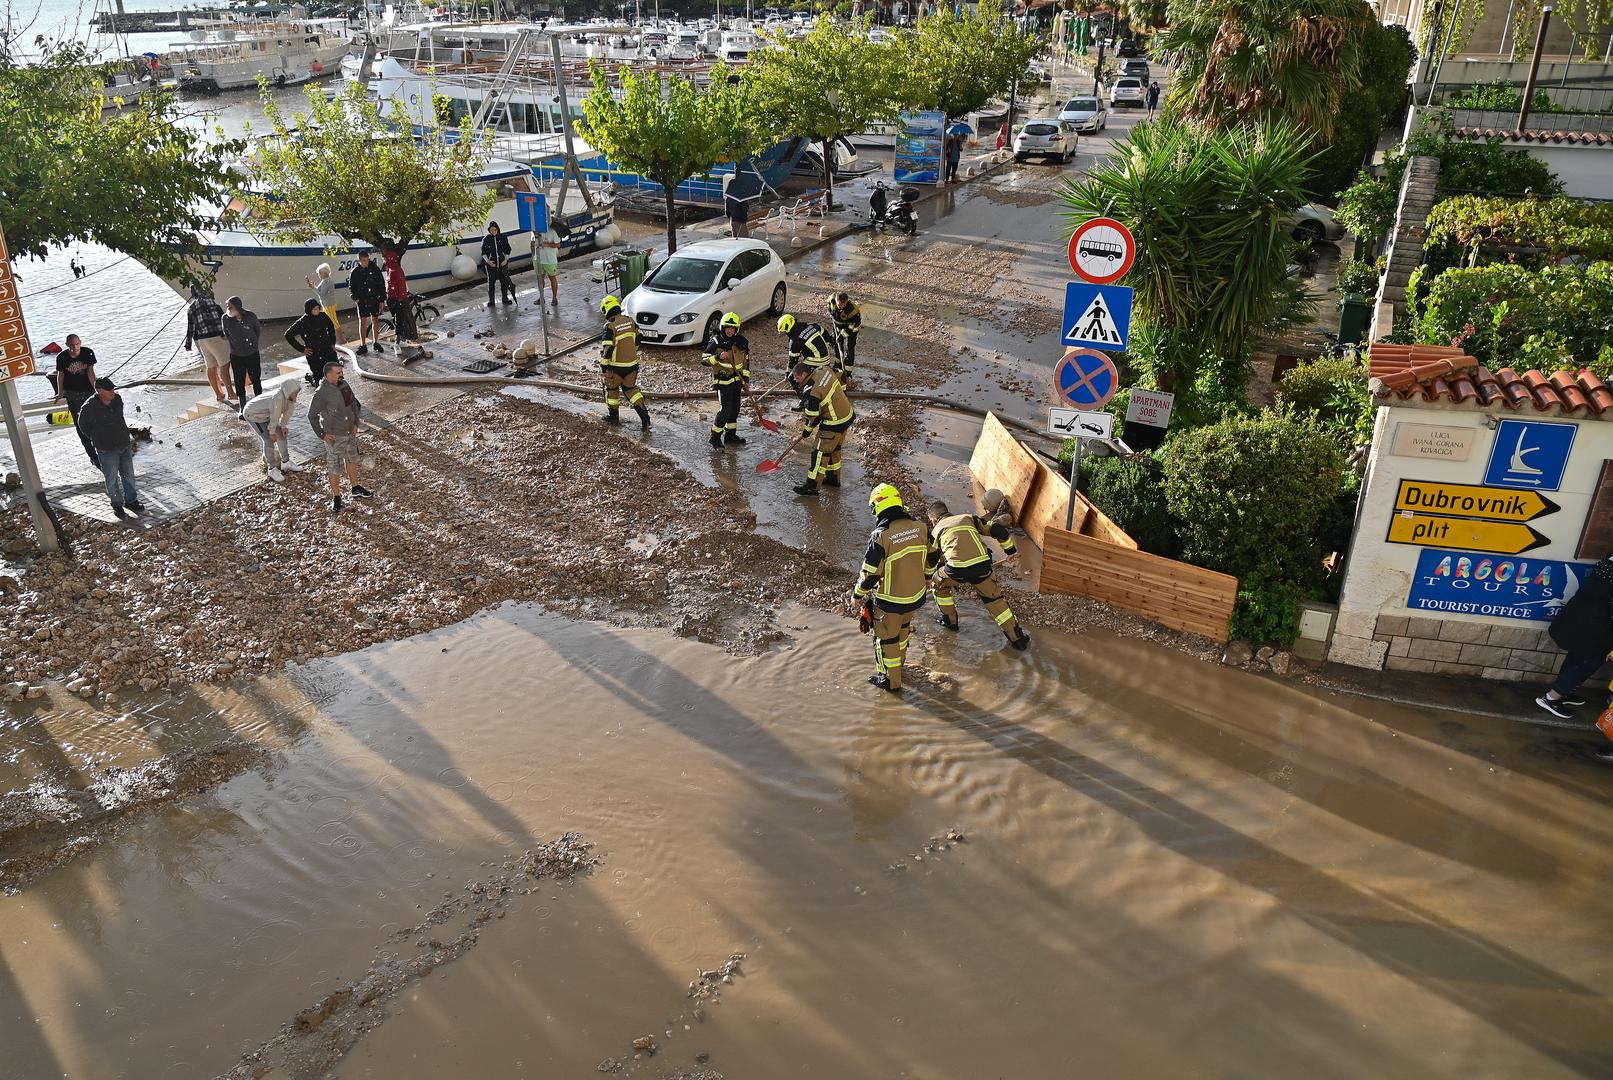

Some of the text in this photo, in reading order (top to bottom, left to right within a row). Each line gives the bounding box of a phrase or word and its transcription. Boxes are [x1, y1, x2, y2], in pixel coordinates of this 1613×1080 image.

[1132, 396, 1171, 410] APARTMANI
[1140, 406, 1158, 418] SOBE
[1412, 438, 1464, 448] IVANA GORANA
[1404, 487, 1527, 515] Dubrovnik
[1435, 556, 1551, 586] ARGOLA
[1423, 576, 1553, 597] TOURS
[1418, 598, 1480, 613] TOURIST
[1480, 605, 1532, 618] OFFICE
